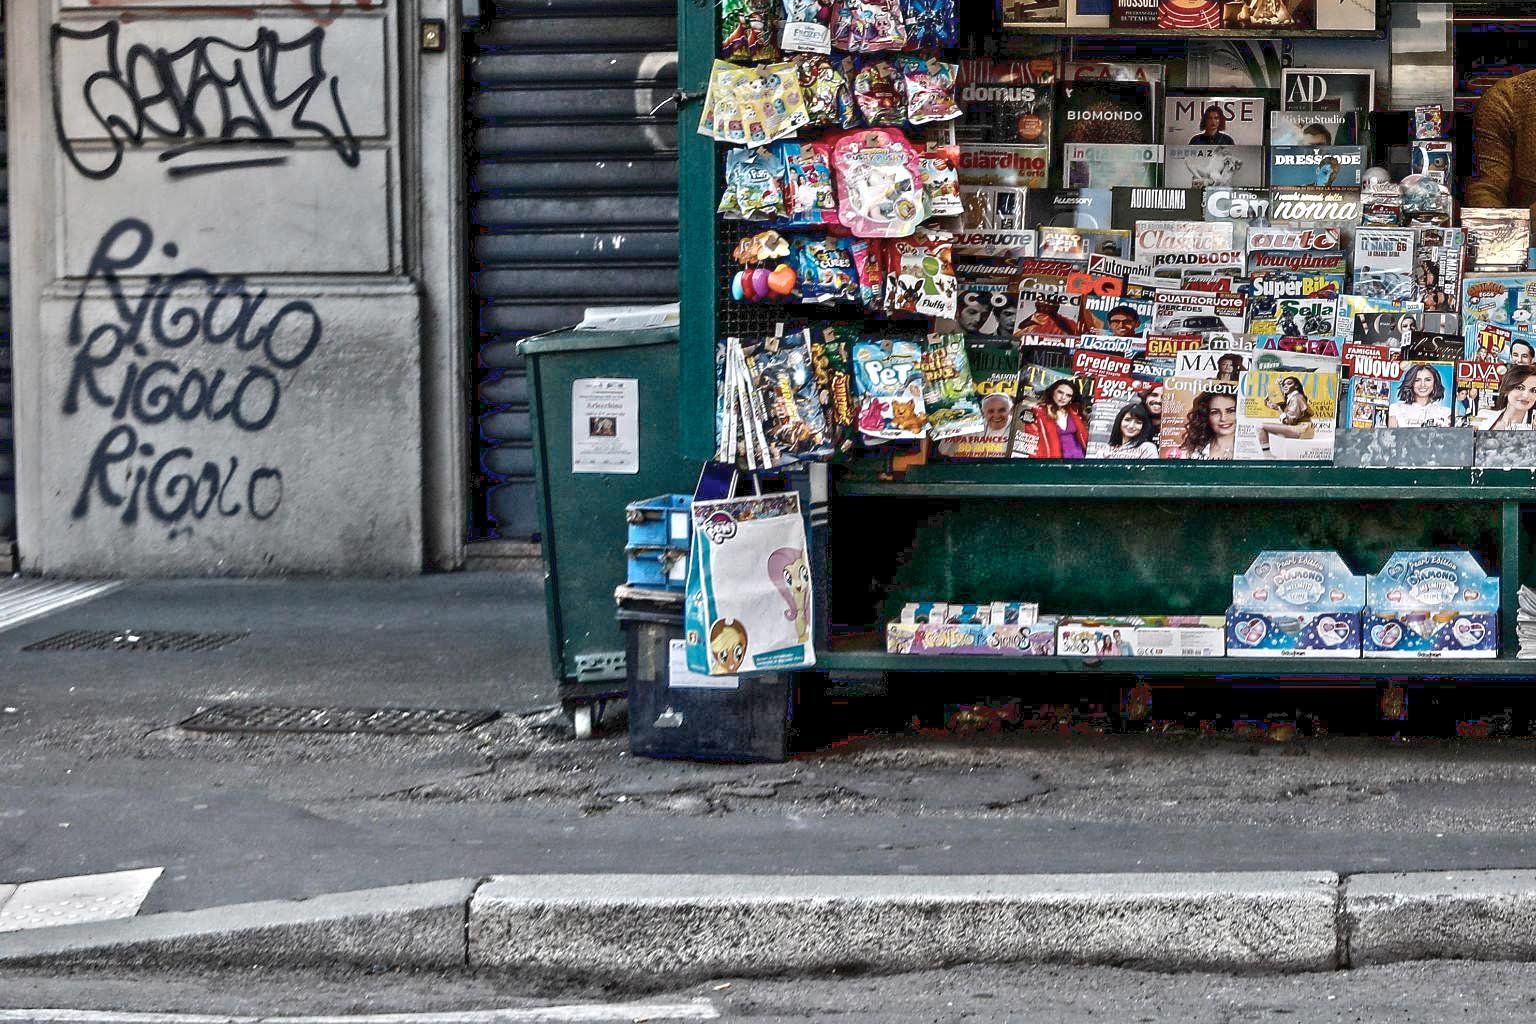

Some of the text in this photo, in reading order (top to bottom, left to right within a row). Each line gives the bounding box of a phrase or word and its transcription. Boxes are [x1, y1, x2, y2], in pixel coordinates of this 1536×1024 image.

[961, 83, 1036, 103] domus
[1288, 75, 1328, 103] AD
[1066, 111, 1143, 121] BIOMONDO
[1130, 188, 1186, 210] AUTOITALIANA
[1273, 202, 1359, 221] nonna
[1155, 251, 1242, 265] ROADBOOK
[1076, 355, 1131, 374] Credere
[1353, 357, 1400, 378] NUOVO
[1458, 362, 1499, 381] DIVA
[1098, 379, 1127, 389] Love
[1100, 387, 1135, 402] Story
